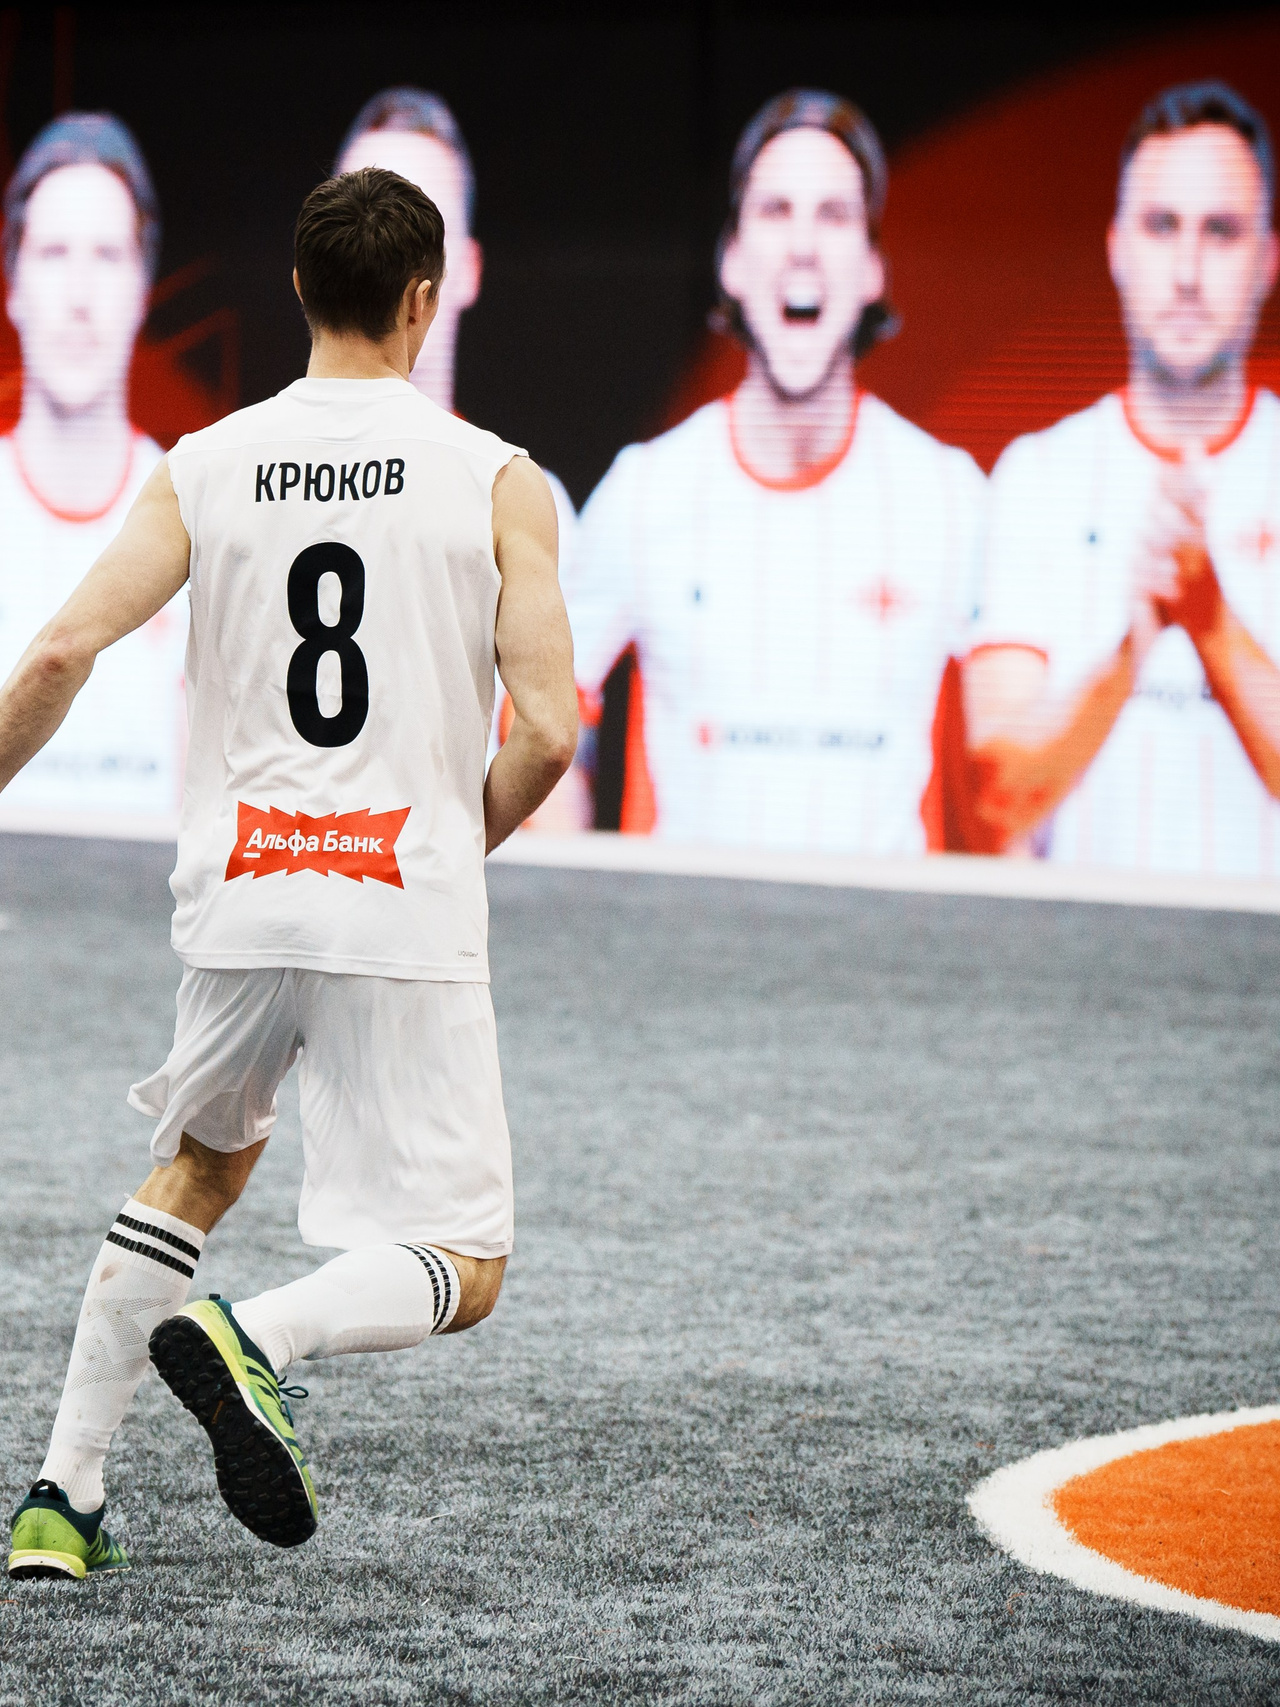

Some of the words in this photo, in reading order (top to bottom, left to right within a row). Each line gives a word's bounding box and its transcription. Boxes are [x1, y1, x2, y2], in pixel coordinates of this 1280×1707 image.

[255, 458, 405, 503] КРЮКОВ
[286, 541, 370, 748] 8
[243, 827, 320, 858] Альфа
[322, 829, 385, 854] Банк
